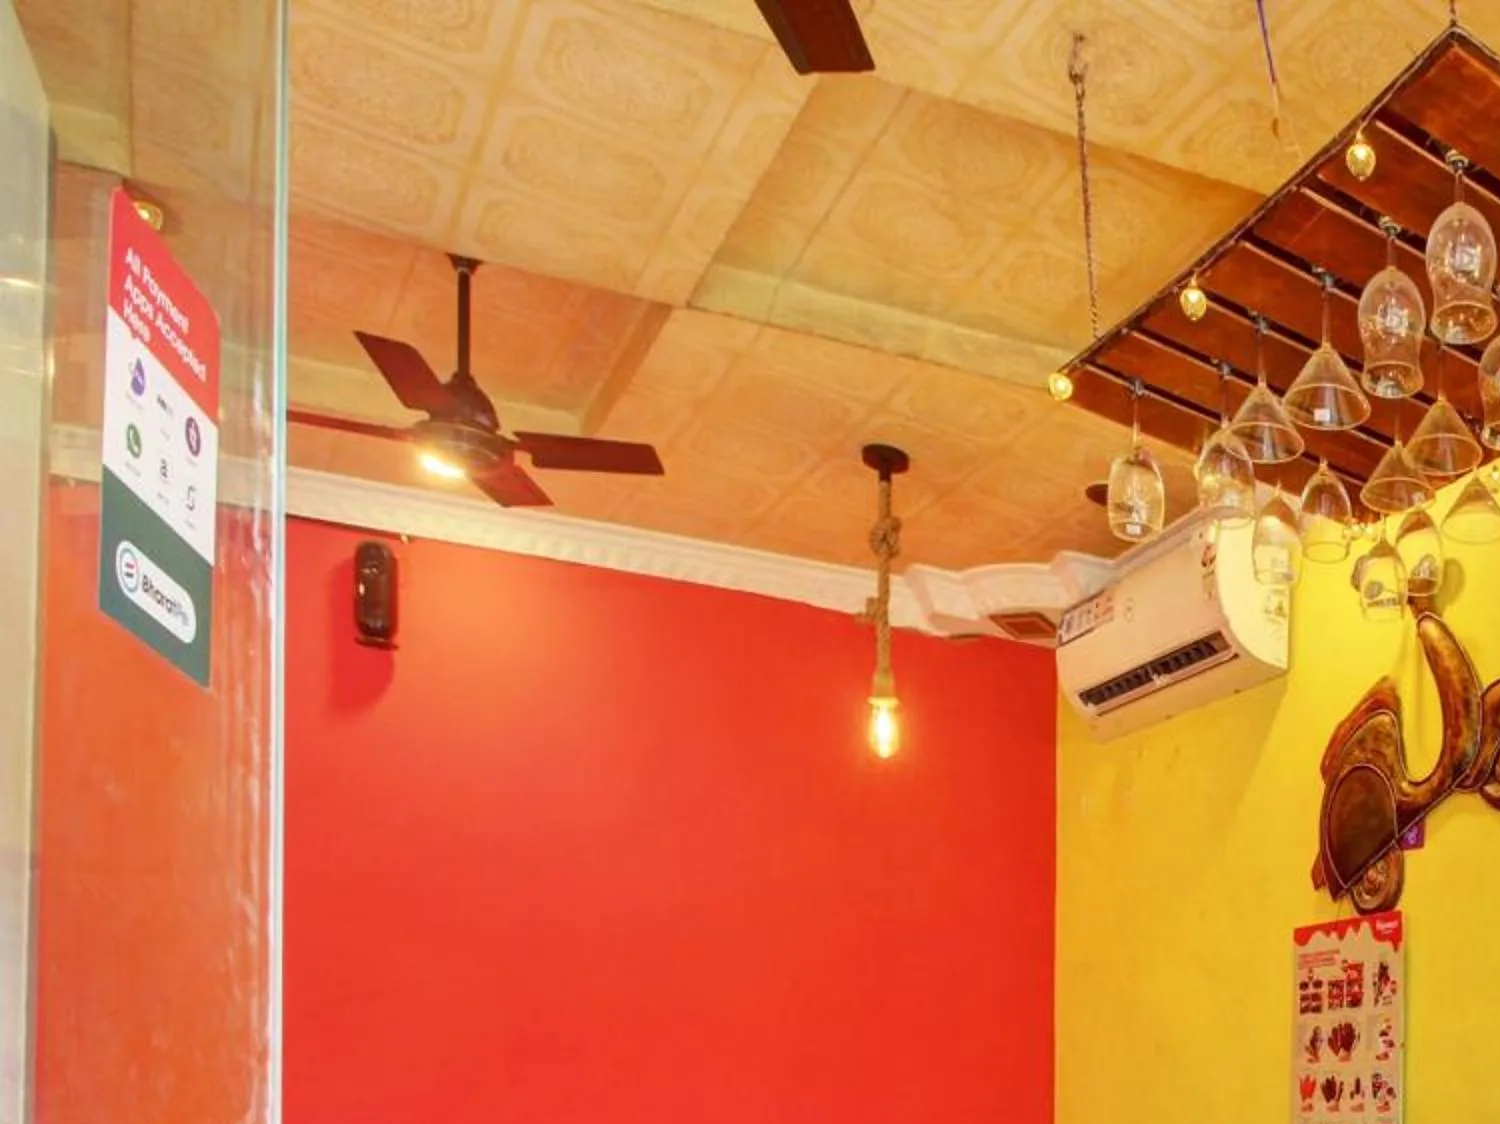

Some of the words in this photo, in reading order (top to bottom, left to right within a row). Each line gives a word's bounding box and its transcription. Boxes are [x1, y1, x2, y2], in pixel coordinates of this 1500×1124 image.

[123, 298, 150, 342] Here
[124, 274, 154, 320] Apps
[155, 311, 206, 382] Accepted
[125, 248, 141, 277] All
[142, 265, 189, 335] Payment
